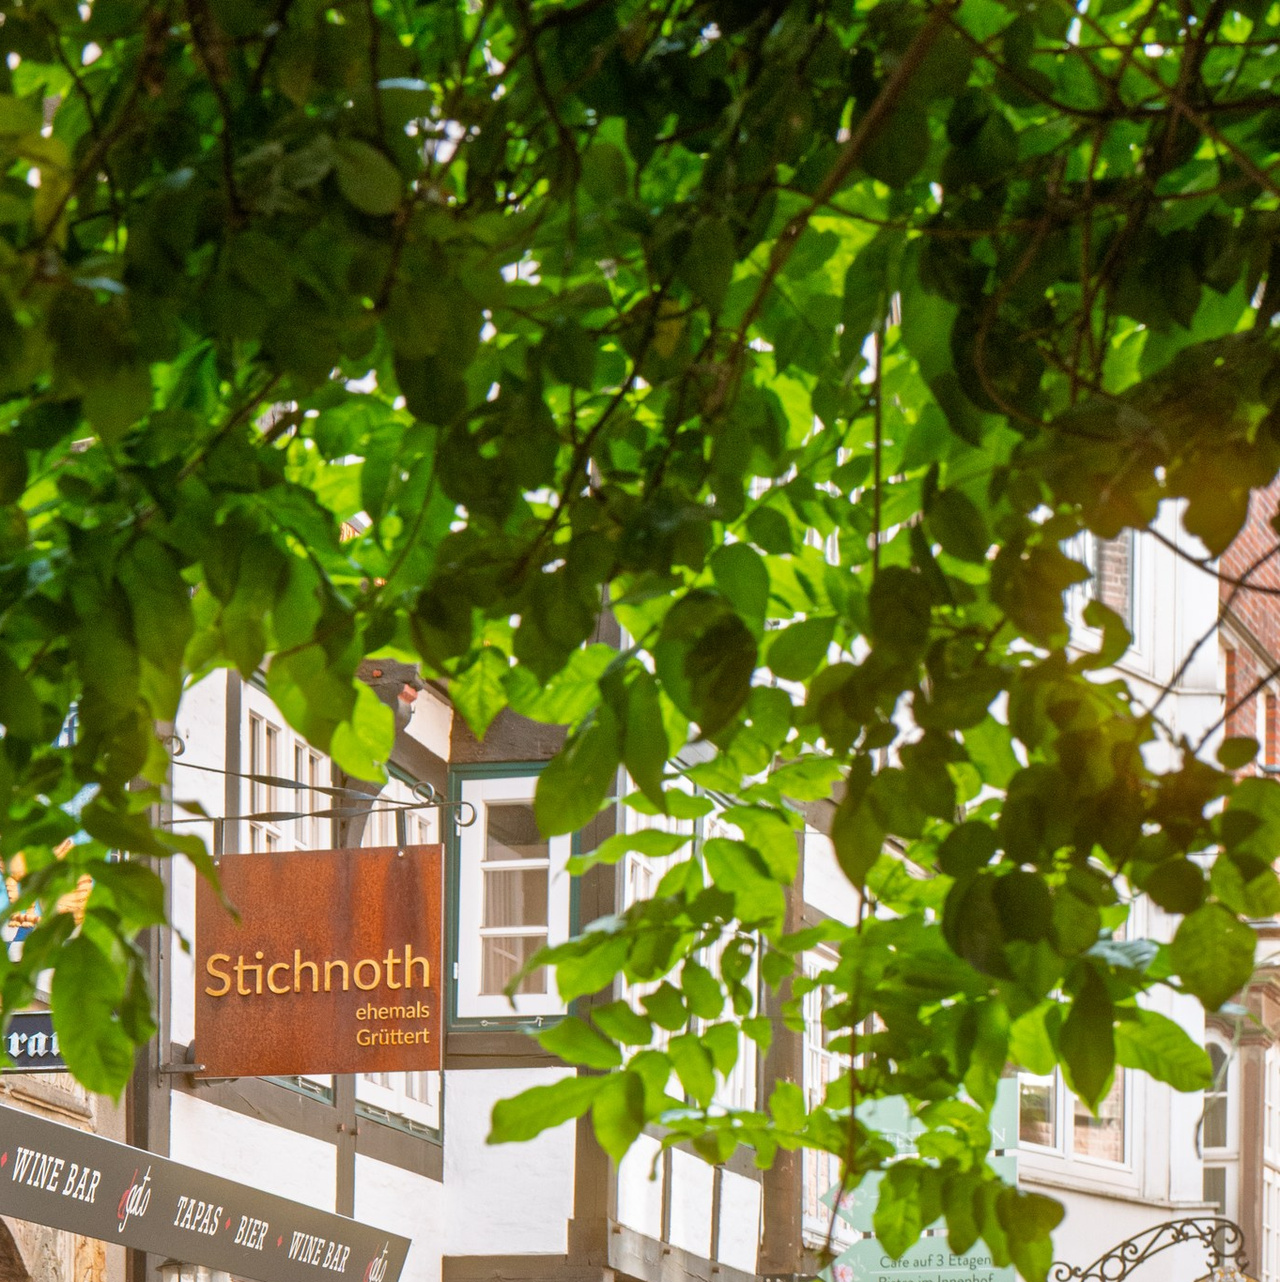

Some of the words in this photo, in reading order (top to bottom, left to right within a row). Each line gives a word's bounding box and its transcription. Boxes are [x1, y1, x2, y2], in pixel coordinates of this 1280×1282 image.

[205, 944, 430, 997] Stichnoth
[356, 1001, 430, 1020] ehemals
[356, 1027, 430, 1046] Grüttert
[12, 1147, 65, 1192] WINE
[62, 1163, 101, 1203] BAR
[173, 1196, 224, 1236] TAPAS
[234, 1215, 269, 1250] BIER
[287, 1231, 326, 1266] WINE
[322, 1241, 351, 1273] BAR
[913, 1254, 933, 1267] auf
[936, 1254, 944, 1267] 3
[949, 1253, 992, 1270] Etagen
